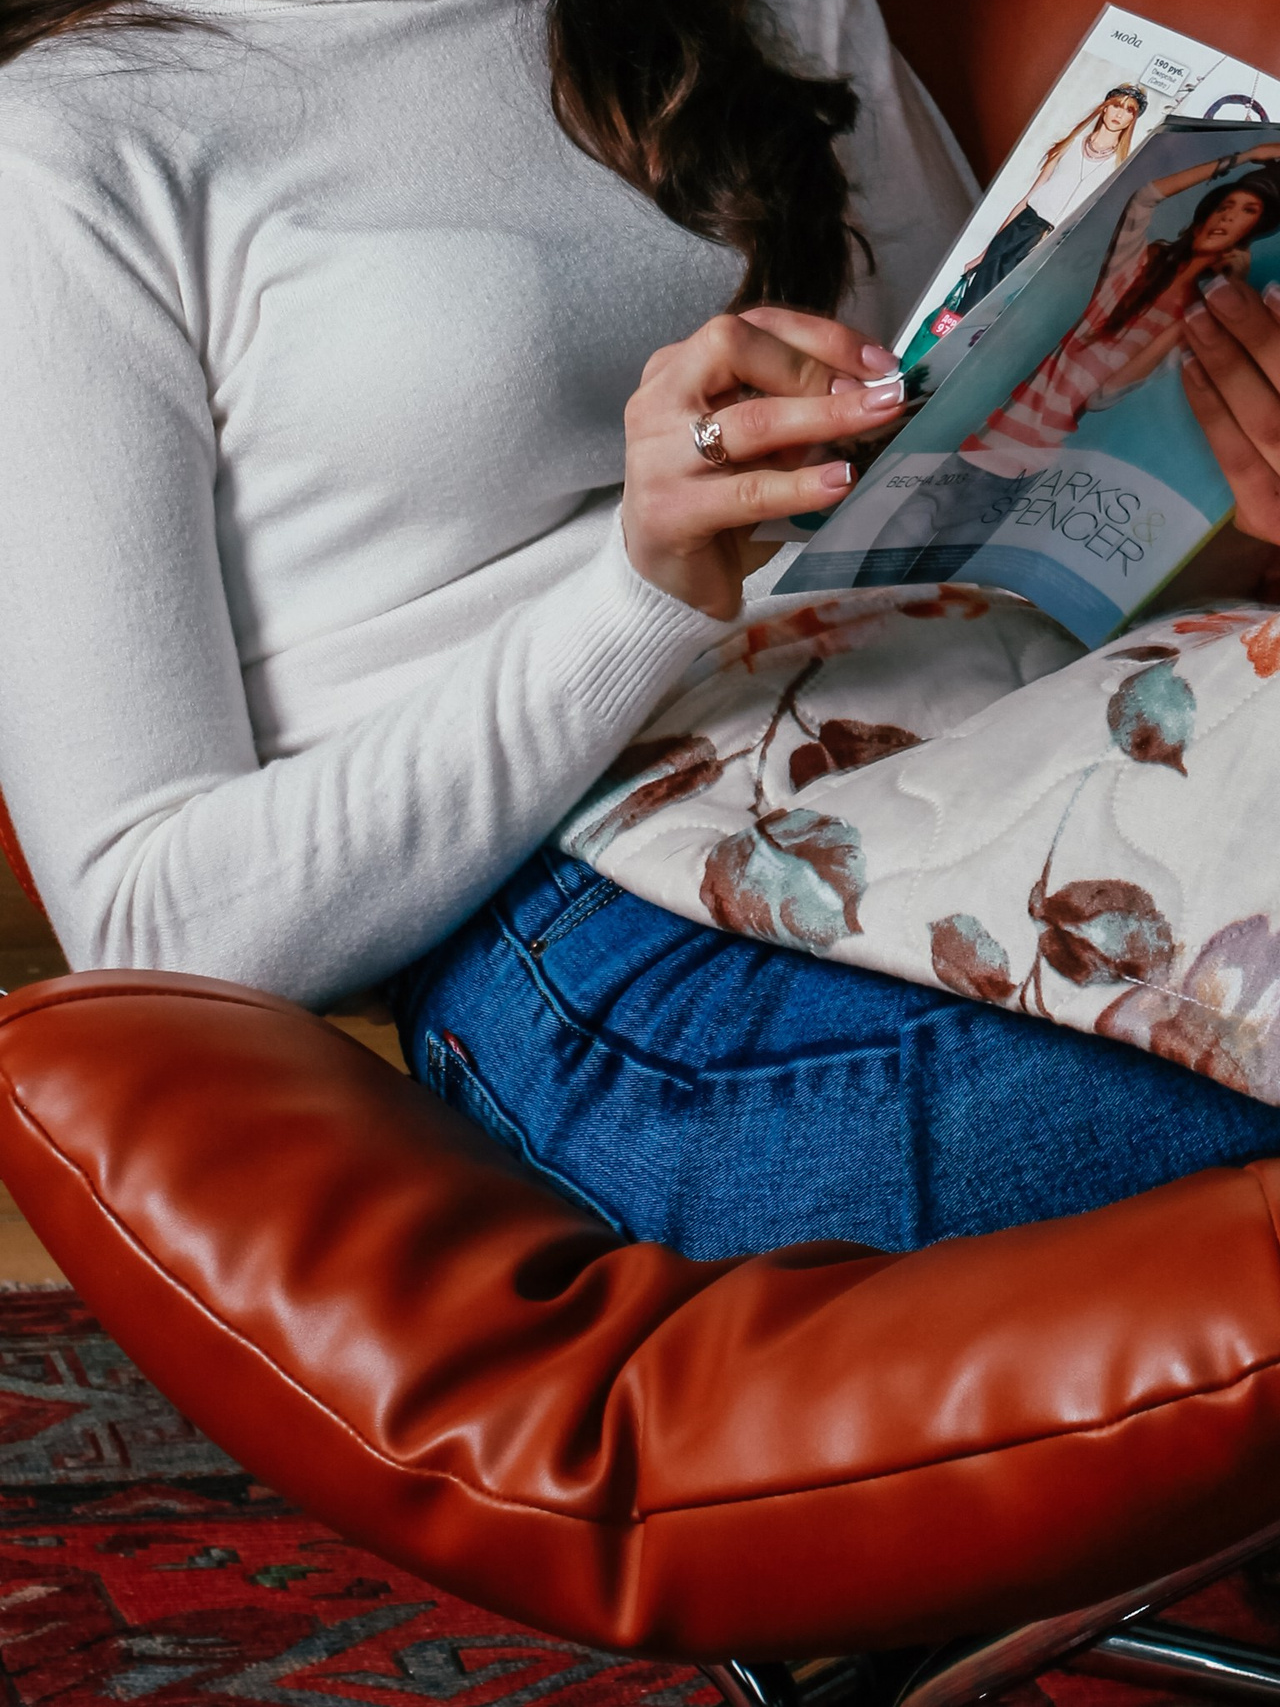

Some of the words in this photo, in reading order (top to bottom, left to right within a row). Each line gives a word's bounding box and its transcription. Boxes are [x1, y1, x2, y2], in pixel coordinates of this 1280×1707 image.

[1111, 30, 1143, 48] мода
[1154, 59, 1169, 69] 190
[1168, 66, 1184, 77] руб.
[886, 475, 934, 488] ВЕСНА
[1005, 468, 1140, 525] MARKS
[981, 496, 1145, 577] SPENCER
